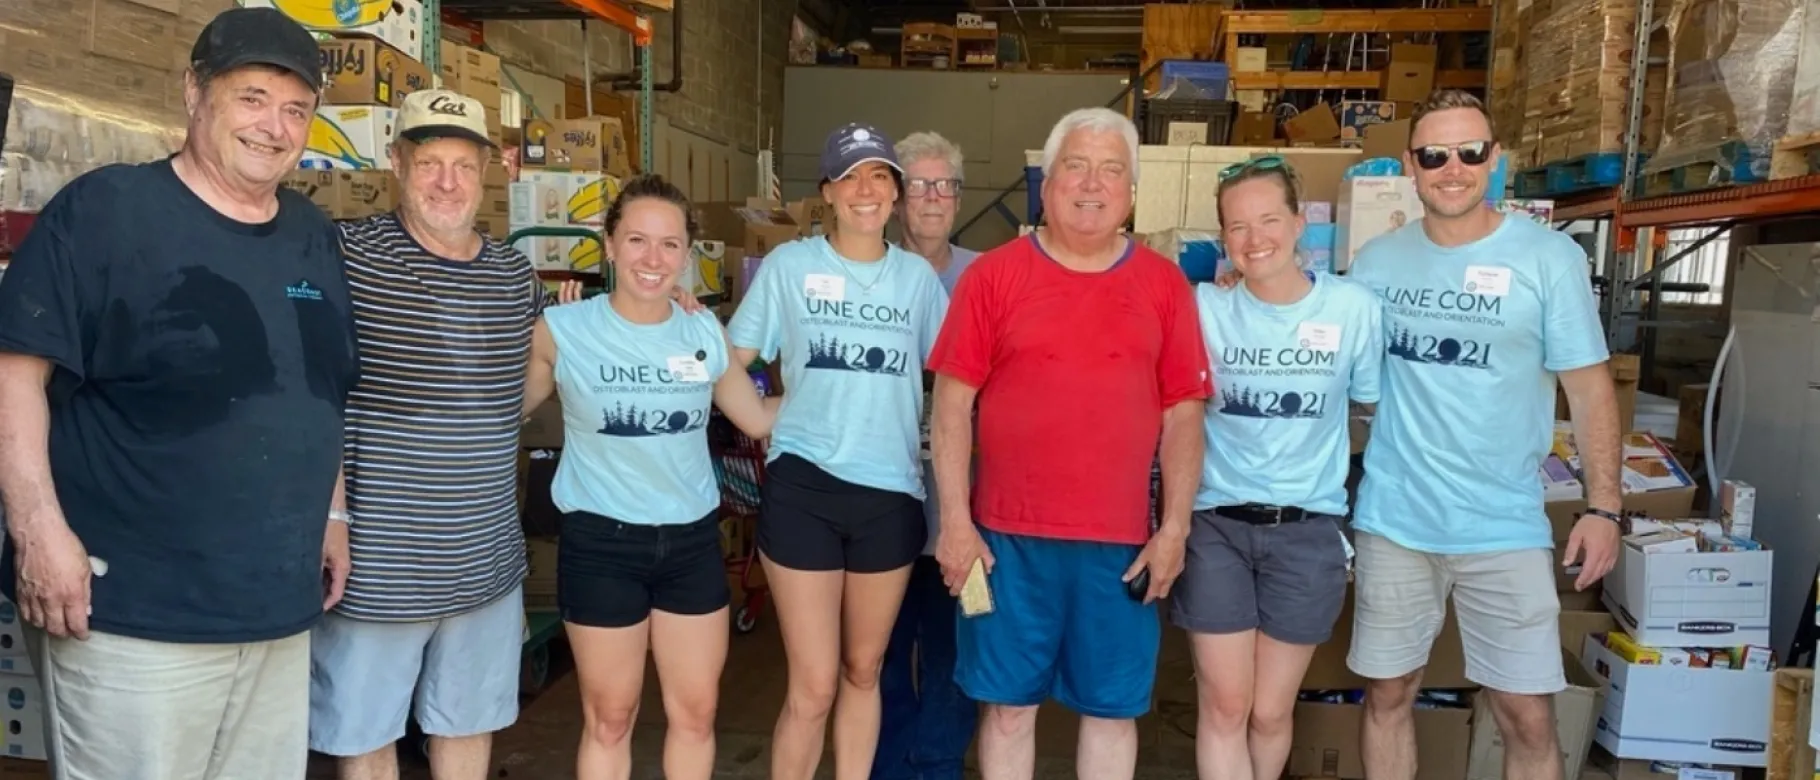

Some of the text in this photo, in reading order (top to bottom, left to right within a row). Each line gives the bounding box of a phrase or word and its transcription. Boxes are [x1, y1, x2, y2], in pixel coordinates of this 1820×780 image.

[806, 297, 911, 325] UNE COM
[1384, 286, 1501, 315] UNE COM
[1444, 312, 1506, 328] ORIENTATION
[850, 342, 909, 375] 2021
[1223, 347, 1335, 367] UNE COM
[1422, 334, 1492, 367] 2021
[599, 364, 652, 384] UNE
[1264, 390, 1327, 418] 2021
